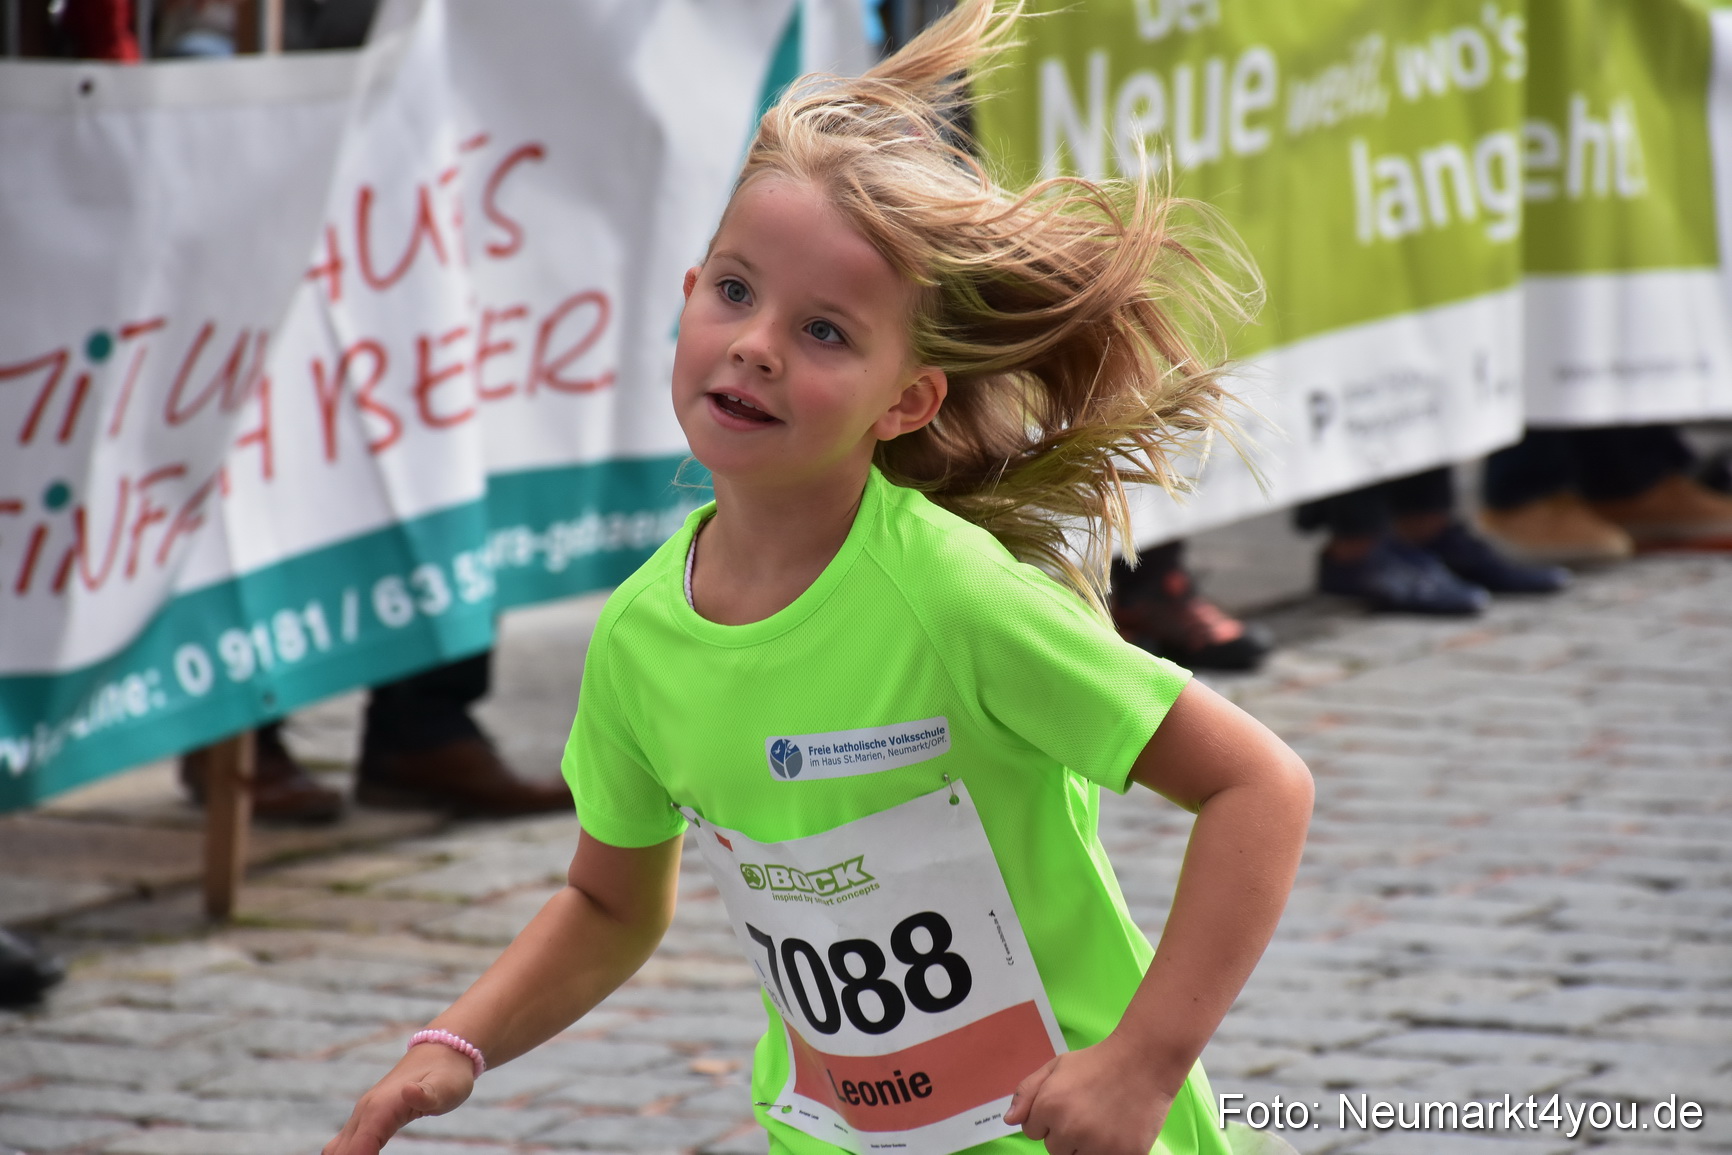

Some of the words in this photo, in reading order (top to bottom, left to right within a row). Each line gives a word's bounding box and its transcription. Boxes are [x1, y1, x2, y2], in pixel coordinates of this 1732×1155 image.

[1040, 45, 1278, 188] Neue
[217, 597, 333, 684] 9181
[807, 745, 832, 756] Freie
[833, 739, 887, 754] katholische
[888, 725, 946, 747] Volksschule
[809, 758, 820, 768] im
[822, 756, 842, 767] Haus
[887, 734, 948, 758] Neumarkt/OPf.
[764, 854, 876, 897] BOCK
[772, 891, 803, 903] inspired
[803, 893, 814, 905] by
[835, 881, 881, 904] concepts
[745, 911, 972, 1035] 7088
[826, 1068, 933, 1107] Leonie
